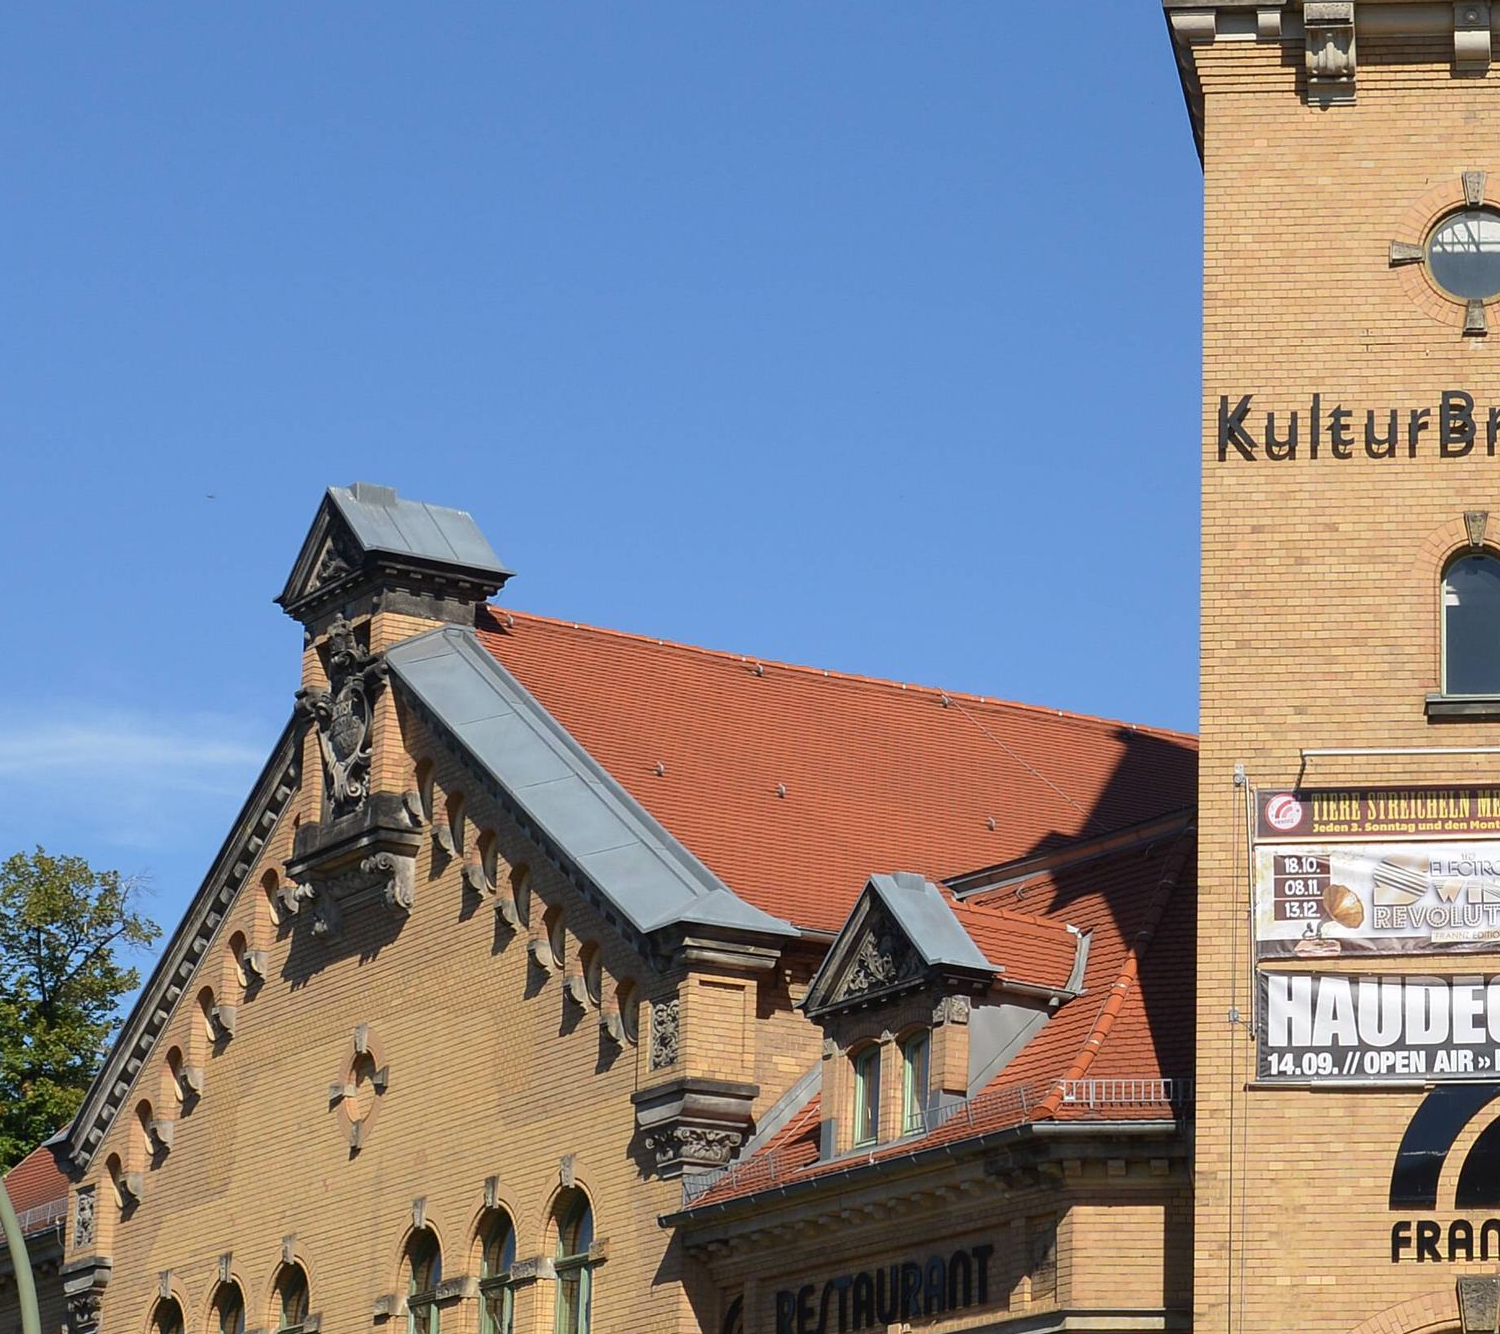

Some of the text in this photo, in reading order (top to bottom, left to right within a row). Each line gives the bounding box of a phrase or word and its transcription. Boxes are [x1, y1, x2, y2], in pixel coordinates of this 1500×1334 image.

[1311, 792, 1361, 821] TIERE
[1367, 790, 1471, 820] STREICHELN
[1312, 823, 1349, 833] Jeden
[1350, 822, 1363, 832] 3.
[1364, 821, 1416, 833] Sonntag
[1416, 821, 1441, 830] und
[1442, 820, 1468, 830] den
[1284, 857, 1321, 874] 18.10.
[1284, 880, 1321, 896] 08.11.
[1284, 900, 1321, 918] 13.12.
[1267, 1051, 1338, 1076] 14.09.
[1342, 1051, 1358, 1075] //
[1363, 1049, 1426, 1075] OPEN
[1434, 1048, 1474, 1073] AIR
